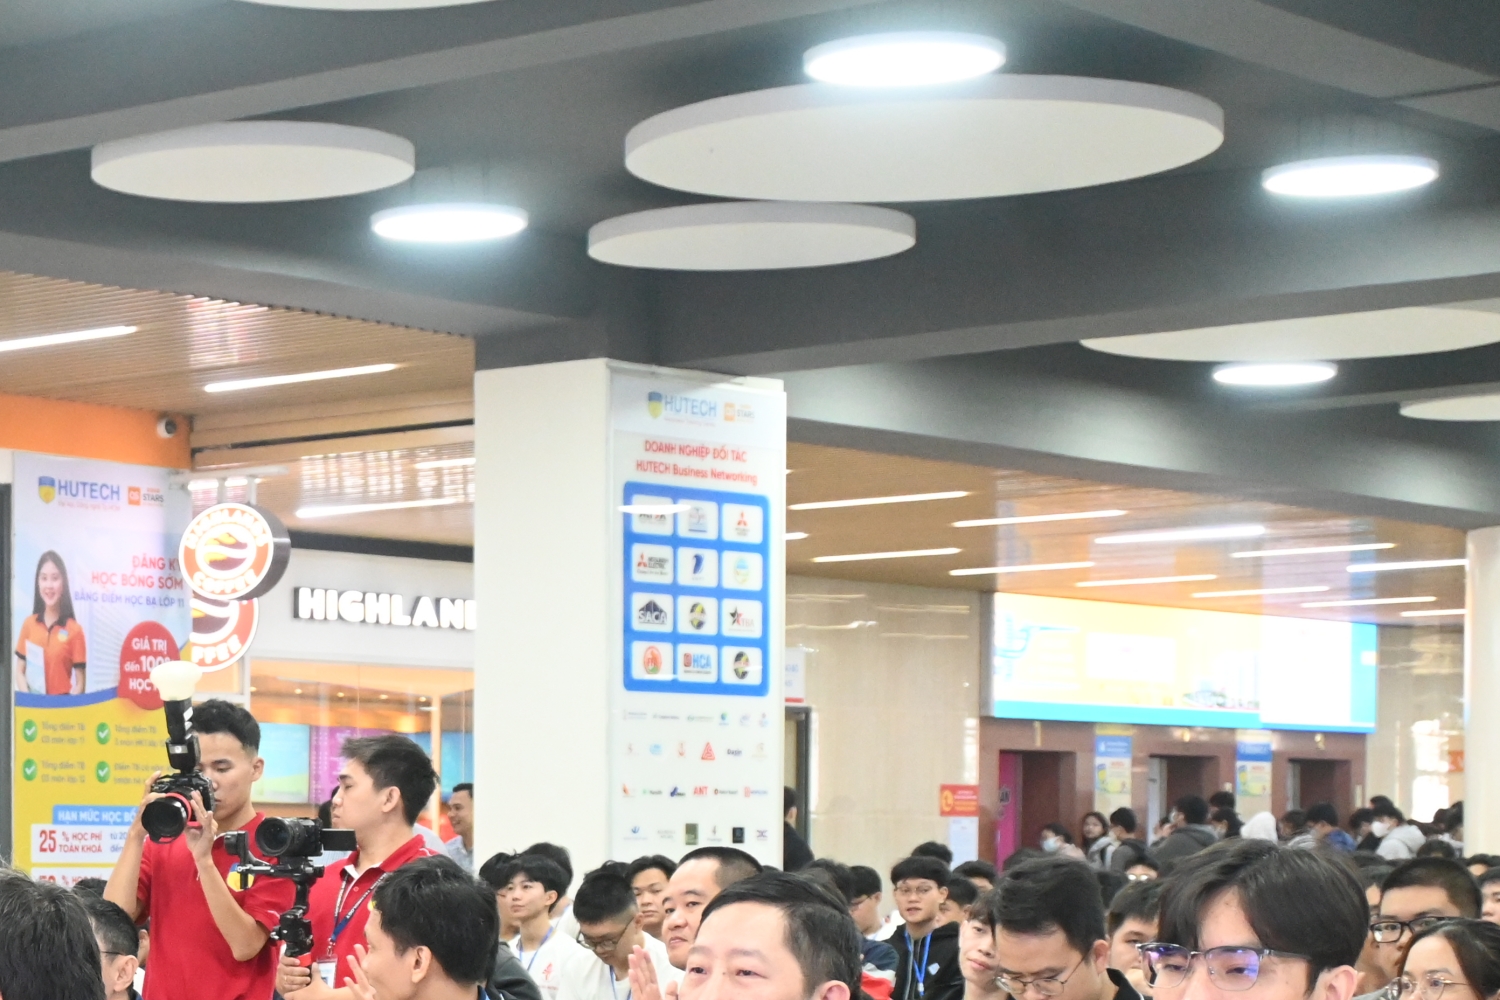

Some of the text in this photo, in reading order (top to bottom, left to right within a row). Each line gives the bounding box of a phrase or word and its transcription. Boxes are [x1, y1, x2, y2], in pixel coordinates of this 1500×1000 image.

[664, 395, 717, 418] HUTECH
[737, 408, 755, 419] STARS
[644, 440, 676, 454] DOANH
[678, 442, 711, 461] NGHIỆP
[713, 444, 729, 461] ĐỐI
[636, 459, 758, 487] HUTECH Business Networking
[58, 479, 120, 501] HUTECH
[143, 493, 165, 503] STARS
[132, 553, 166, 571] ĐĂNG
[91, 568, 184, 590] HỌC BỔNG SỚM
[124, 595, 143, 607] HỌC
[177, 598, 185, 608] 11
[638, 610, 668, 624] SACA
[131, 635, 168, 655] GIÁ TRỊ
[124, 660, 140, 673] đến
[692, 653, 712, 670] HCA
[129, 677, 152, 694] HỌC
[693, 786, 708, 796] ANT
[58, 807, 137, 825] HẠN MỨC HỌC BỔ
[39, 829, 103, 853] 25 % HỌC PHÍ
[119, 832, 127, 840] 20
[59, 843, 79, 853] TOÀN
